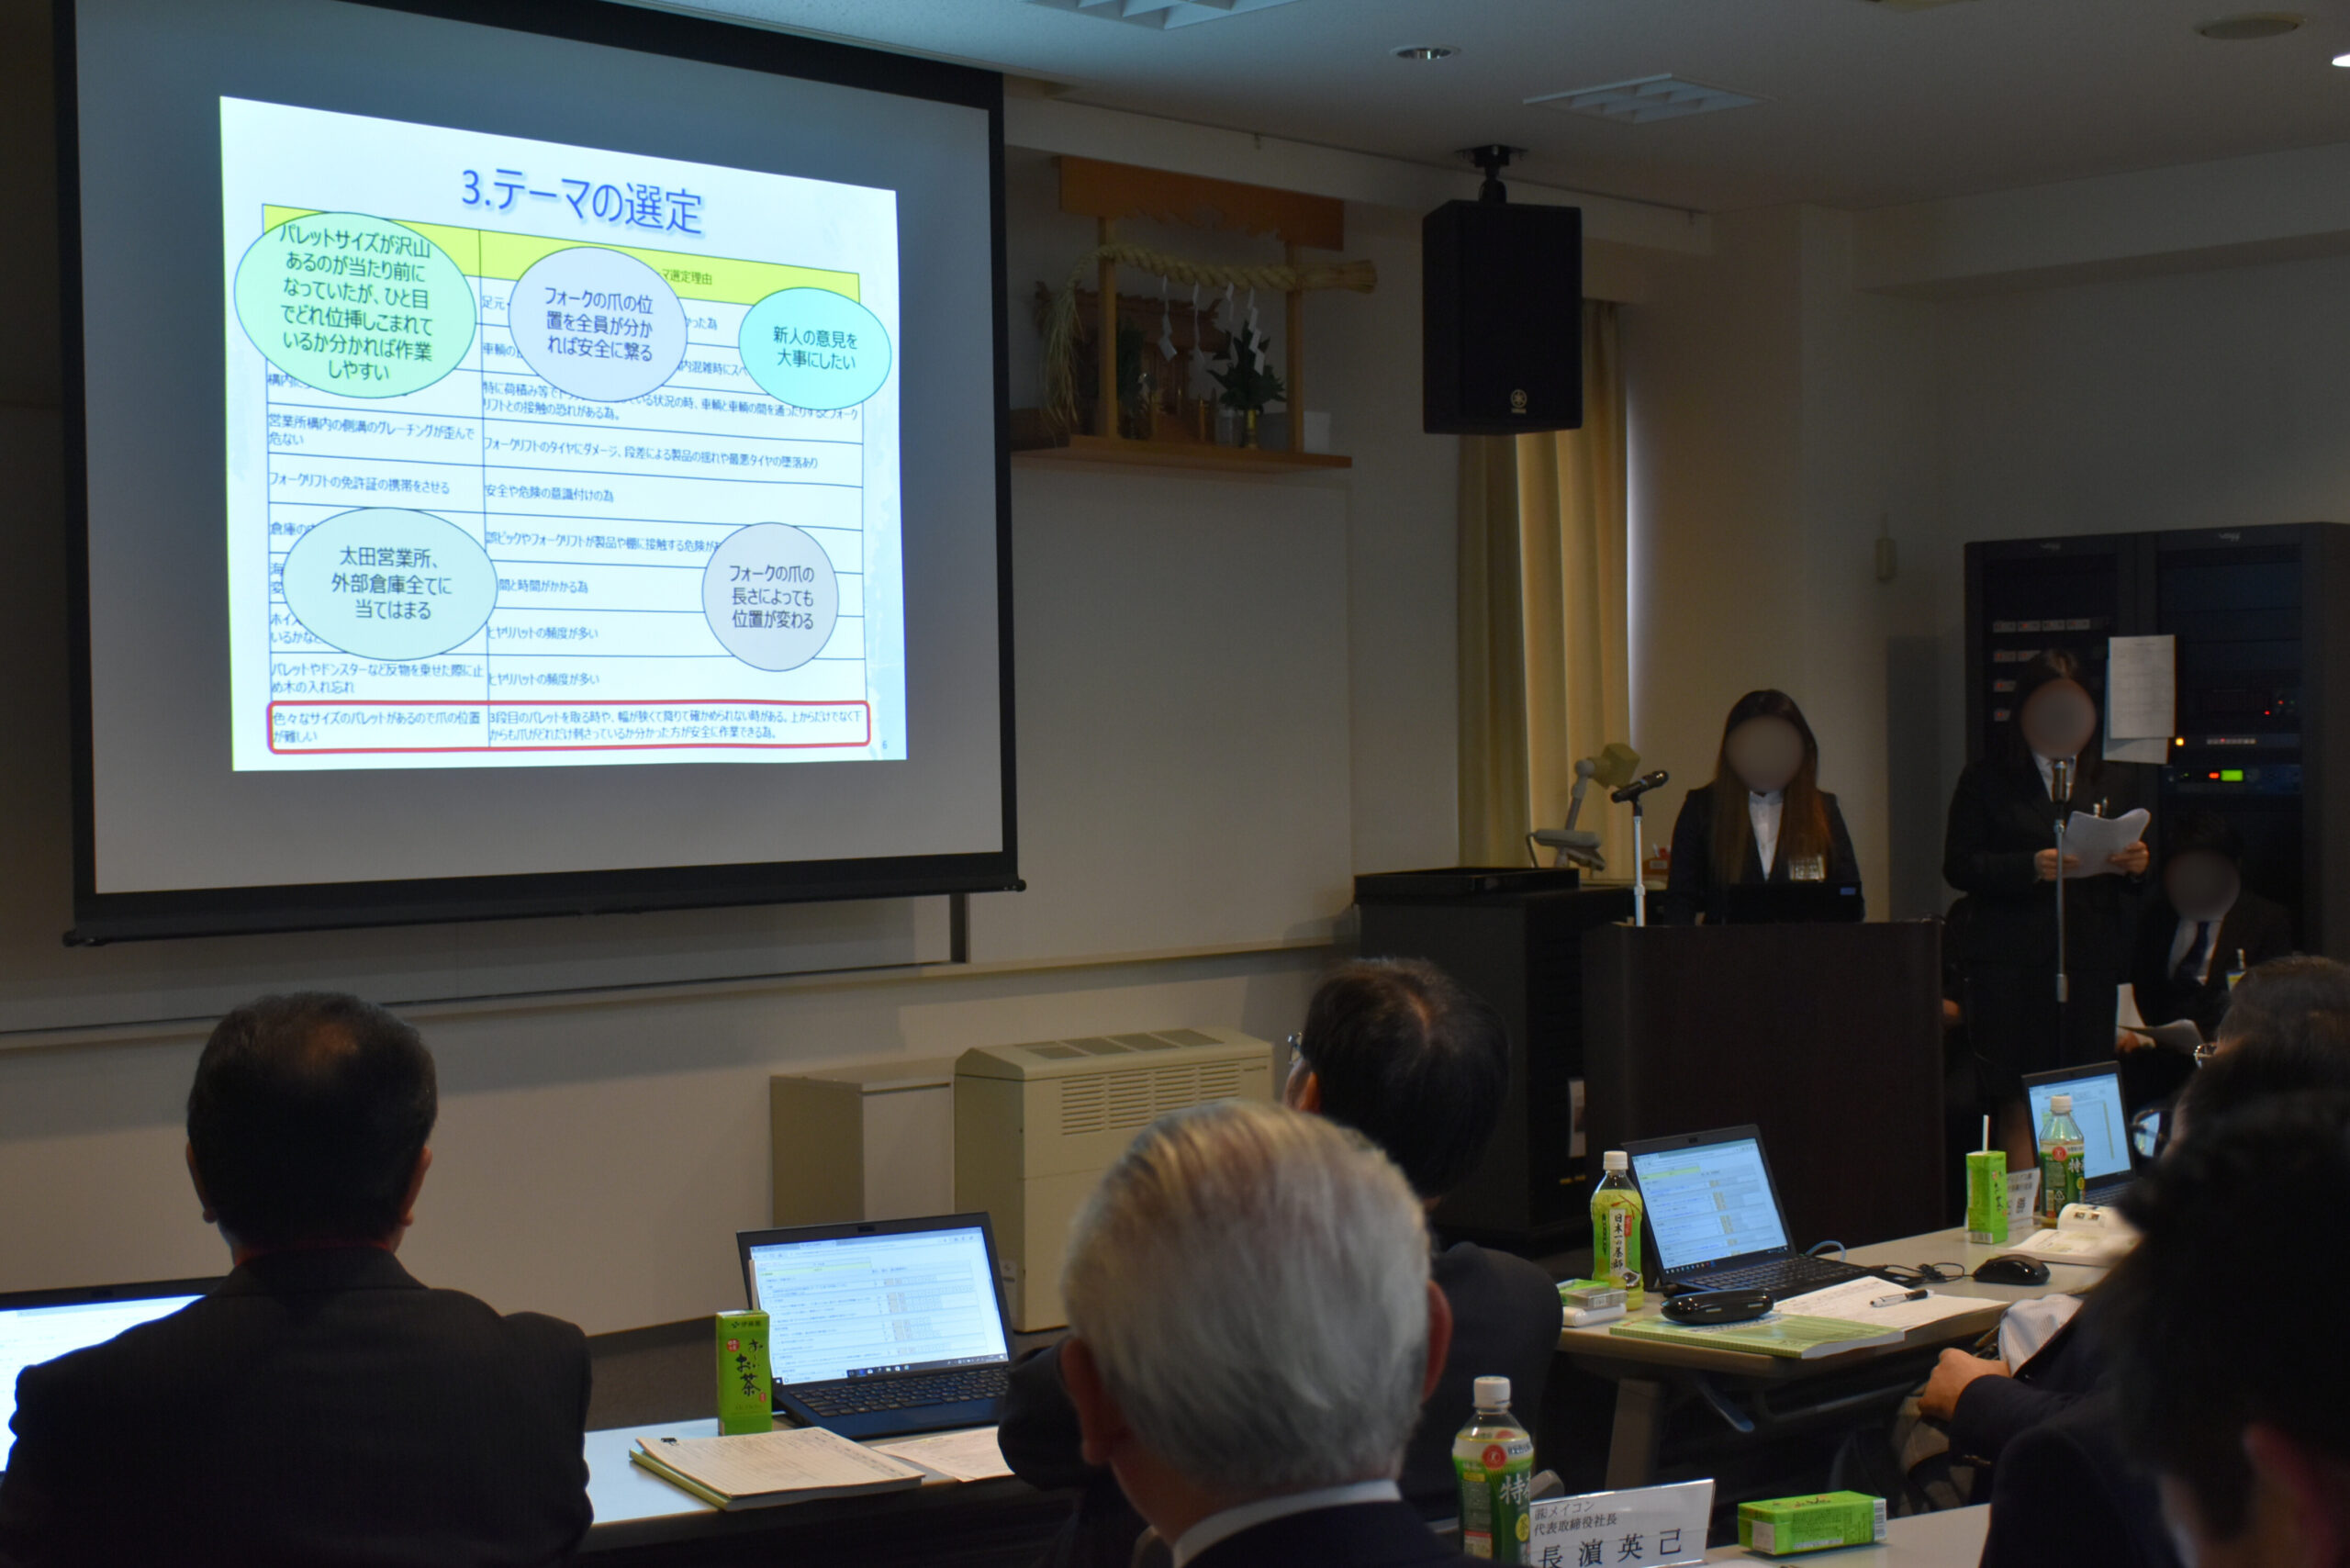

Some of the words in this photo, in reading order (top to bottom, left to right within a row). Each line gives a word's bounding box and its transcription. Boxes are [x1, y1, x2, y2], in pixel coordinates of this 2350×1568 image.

[462, 169, 702, 234] 3.テーマの選定
[280, 224, 431, 258] パレットサイズが沢山
[286, 252, 426, 283] あるのが当たり前に
[284, 277, 429, 309] なっていたが、ひと目
[545, 287, 654, 314] フォークの爪の位
[281, 304, 433, 337] でどれ位挿しこまれて
[546, 310, 653, 340] 置を全員が分か
[283, 331, 432, 363] いるか分かれば作業
[774, 325, 858, 350] 新人の意見を
[327, 359, 390, 382] しやすい
[777, 349, 856, 371] 大事にしたい
[268, 431, 304, 446] 危ない
[339, 545, 439, 569] 太田営業所、
[330, 572, 453, 597] 外部倉庫全てに
[730, 564, 814, 584] フォークの爪の
[732, 587, 814, 608] 長さによっても
[355, 599, 431, 621] 当てはまる
[732, 609, 814, 631] 位置が変わる
[273, 711, 481, 726] 色々なサイズのパレットがあるので爪の位置
[273, 730, 319, 744] が難しい
[1534, 1513, 1617, 1537] 代表取締役社長
